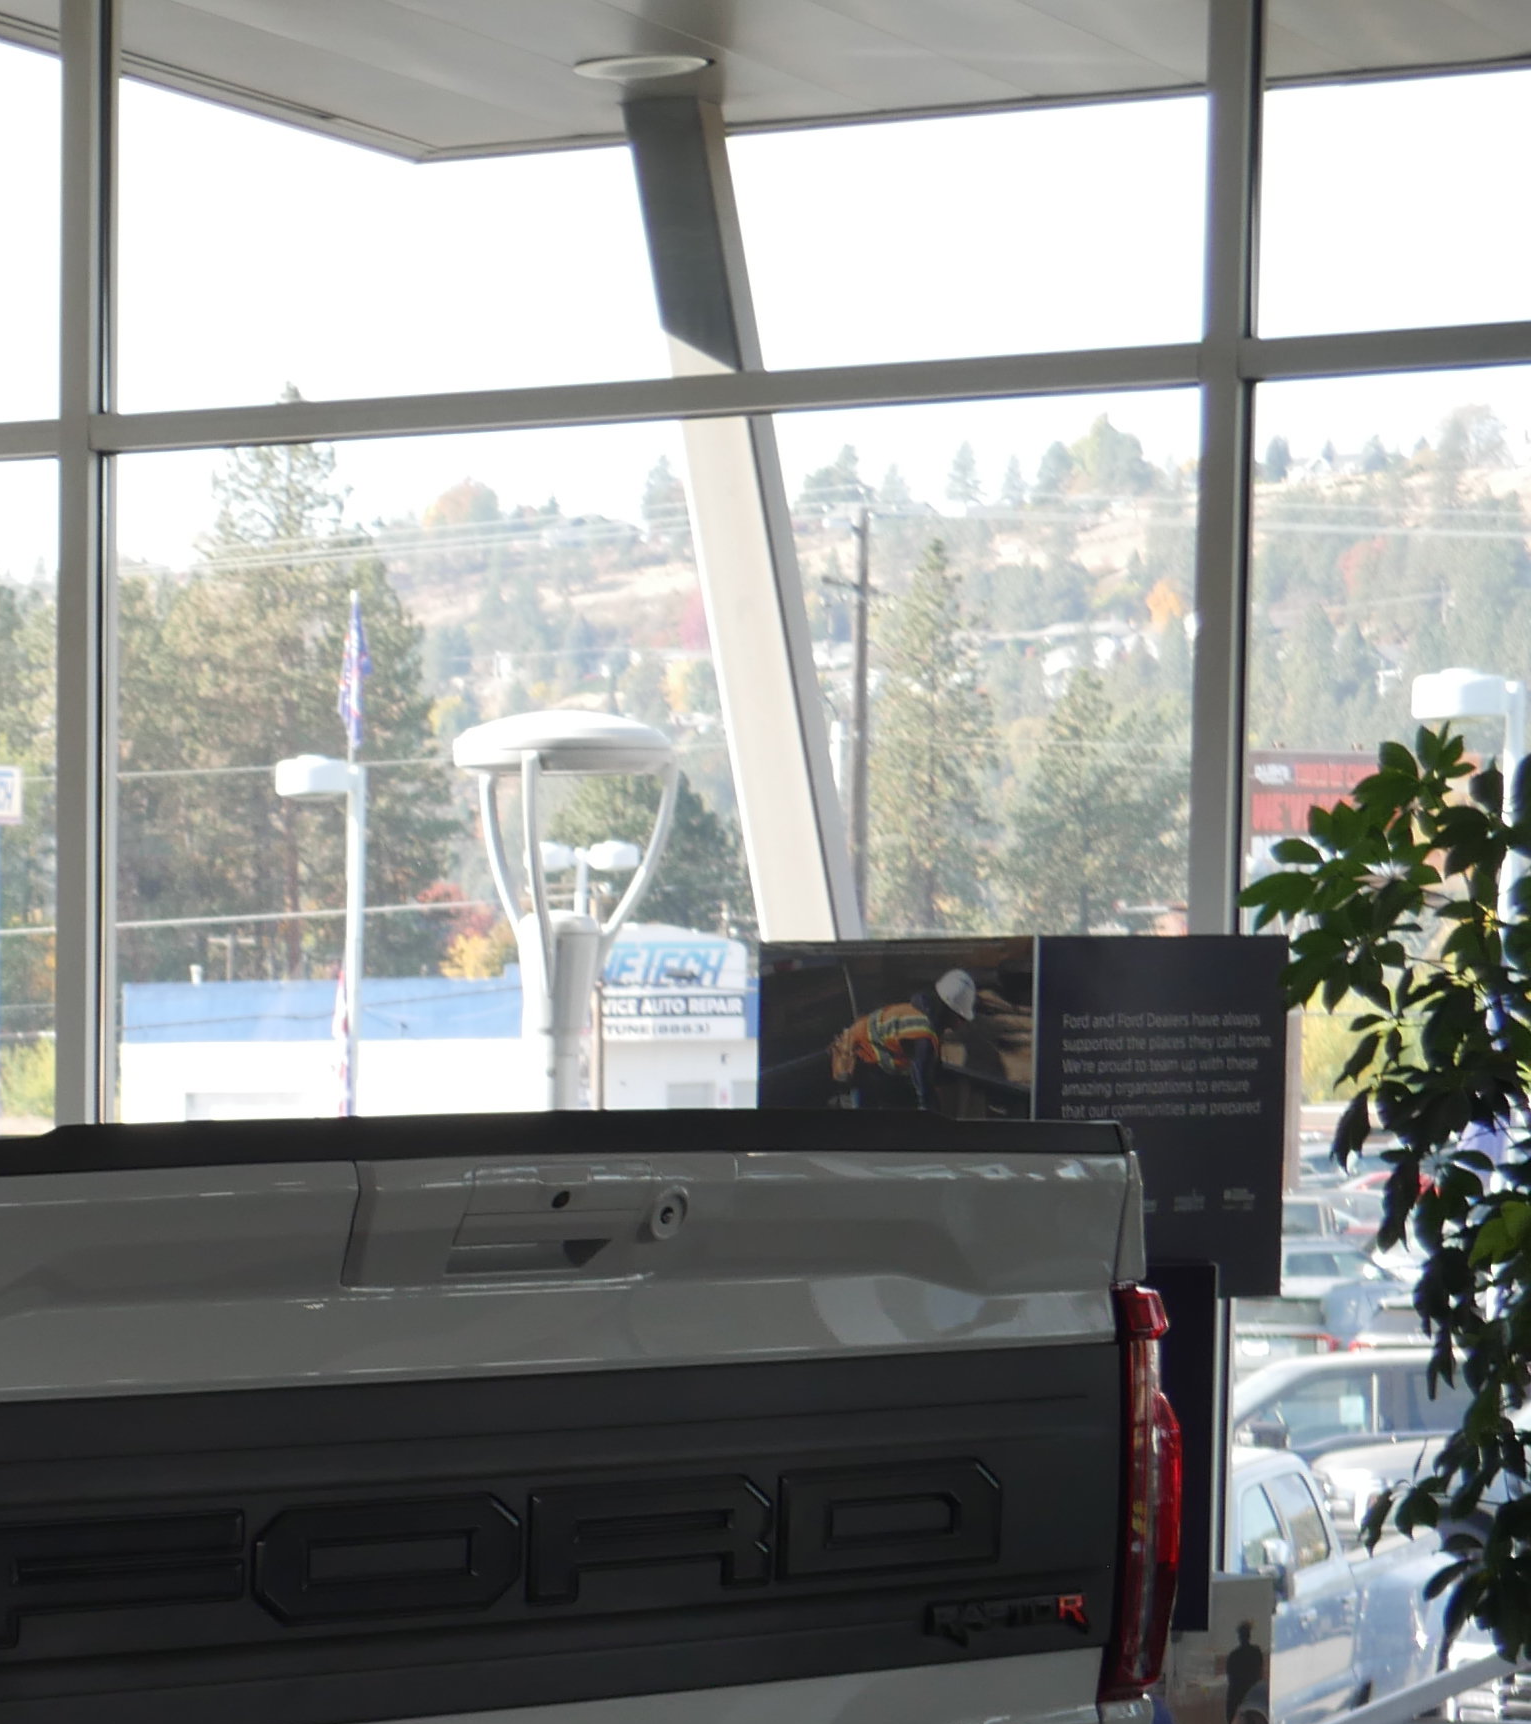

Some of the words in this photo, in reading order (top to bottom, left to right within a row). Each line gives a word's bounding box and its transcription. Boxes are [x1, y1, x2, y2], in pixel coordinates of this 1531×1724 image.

[641, 998, 686, 1015] AUTO
[688, 997, 743, 1015] REPAIR
[1063, 1013, 1090, 1028] Ford
[1092, 1013, 1114, 1027] and
[1118, 1012, 1143, 1027] Ford
[1147, 1012, 1189, 1027] Dealers
[1192, 1013, 1219, 1026] have
[1222, 1012, 1260, 1028] always
[1062, 1036, 1124, 1051] supported
[1127, 1036, 1146, 1049] the
[1148, 1036, 1185, 1050] places
[1189, 1035, 1213, 1050] they
[1216, 1034, 1236, 1048] call
[1062, 1058, 1095, 1073] We're
[1097, 1058, 1132, 1074] proud
[1135, 1059, 1147, 1072] to
[1150, 1059, 1179, 1072] team
[1181, 1060, 1196, 1073] up
[1199, 1057, 1224, 1070] with
[1226, 1056, 1258, 1070] these
[1061, 1081, 1112, 1097] amazing
[1115, 1079, 1193, 1097] organizations
[1195, 1080, 1208, 1093] to
[1211, 1079, 1250, 1093] ensure
[1061, 1103, 1085, 1118] that
[1089, 1104, 1110, 1117] our
[1111, 1103, 1186, 1116] communities
[1189, 1102, 1207, 1115] are
[1209, 1100, 1261, 1116] prepared
